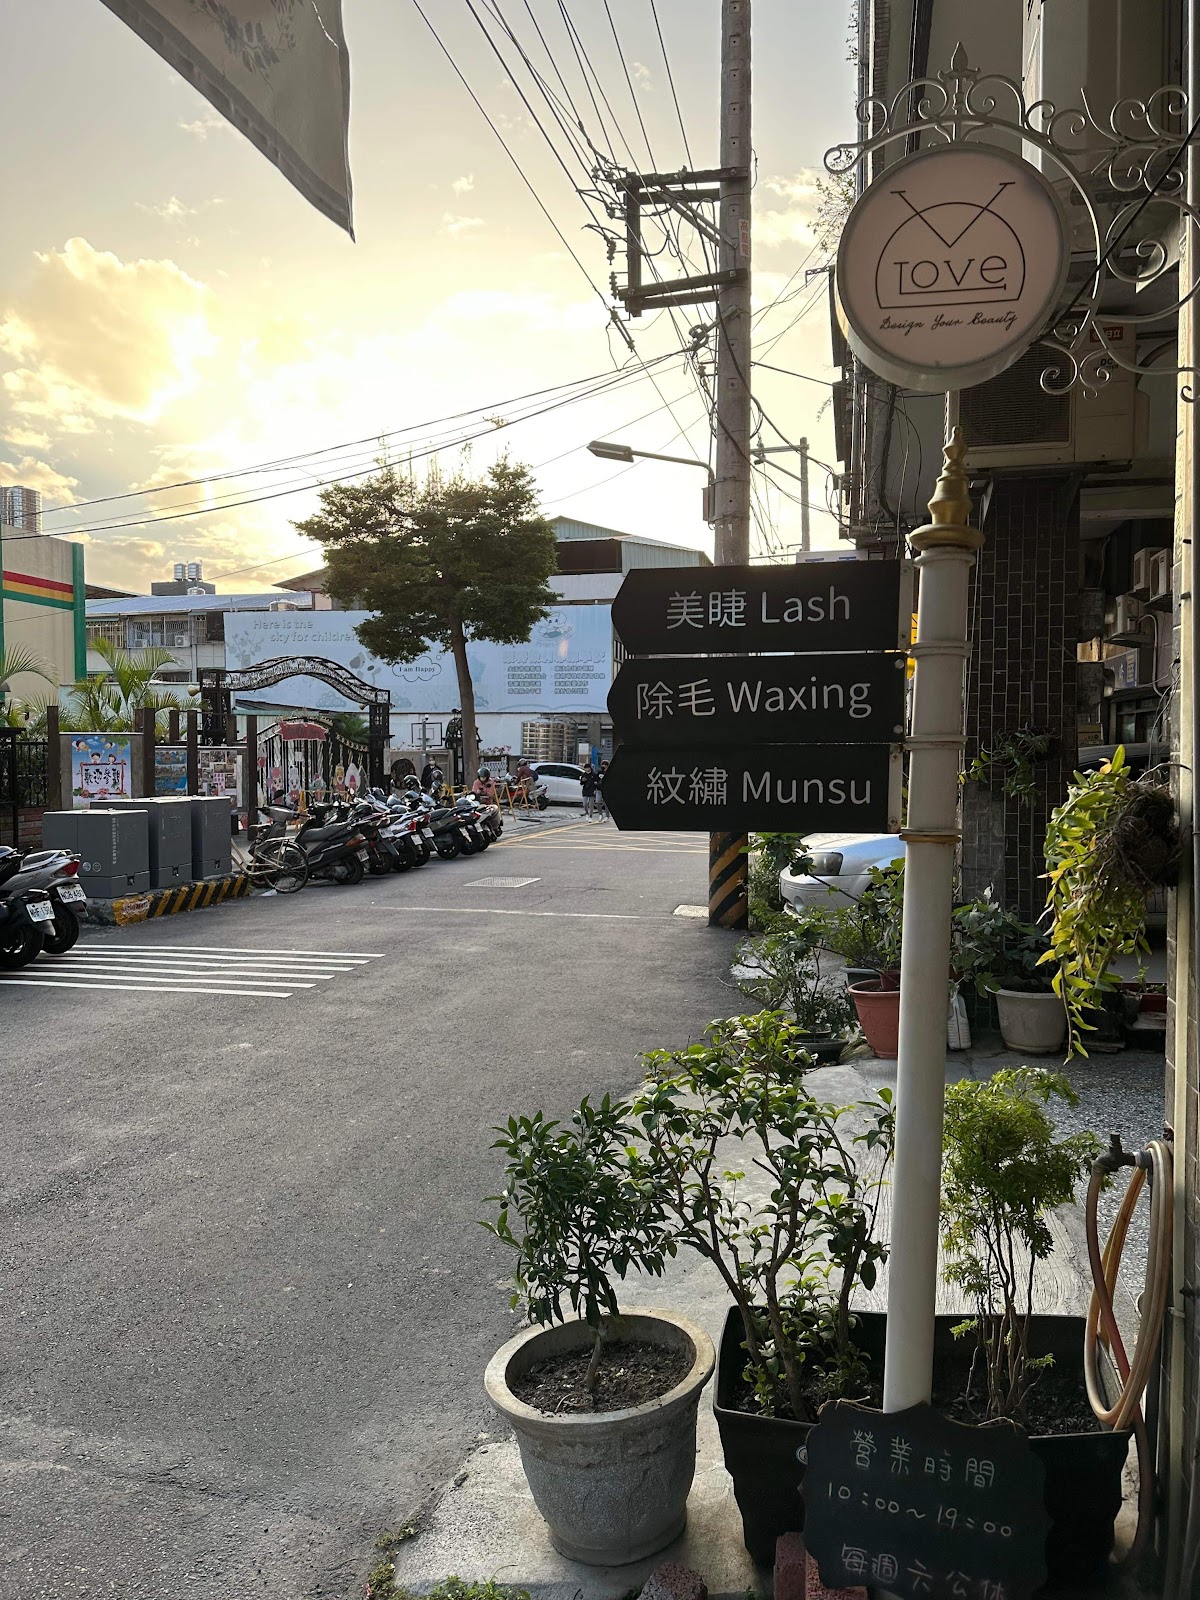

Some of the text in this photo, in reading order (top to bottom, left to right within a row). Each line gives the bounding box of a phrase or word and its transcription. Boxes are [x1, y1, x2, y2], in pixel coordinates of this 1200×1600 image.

[880, 310, 1018, 337] Design Your Beauty
[253, 619, 314, 630] Here is the
[666, 585, 850, 630] 美睫 Lash
[270, 631, 289, 645] sky
[291, 631, 311, 643] for
[637, 677, 872, 720] 除毛 Waxing
[646, 766, 872, 806] 紋繡 Munsu
[850, 1429, 995, 1488] 營業時間
